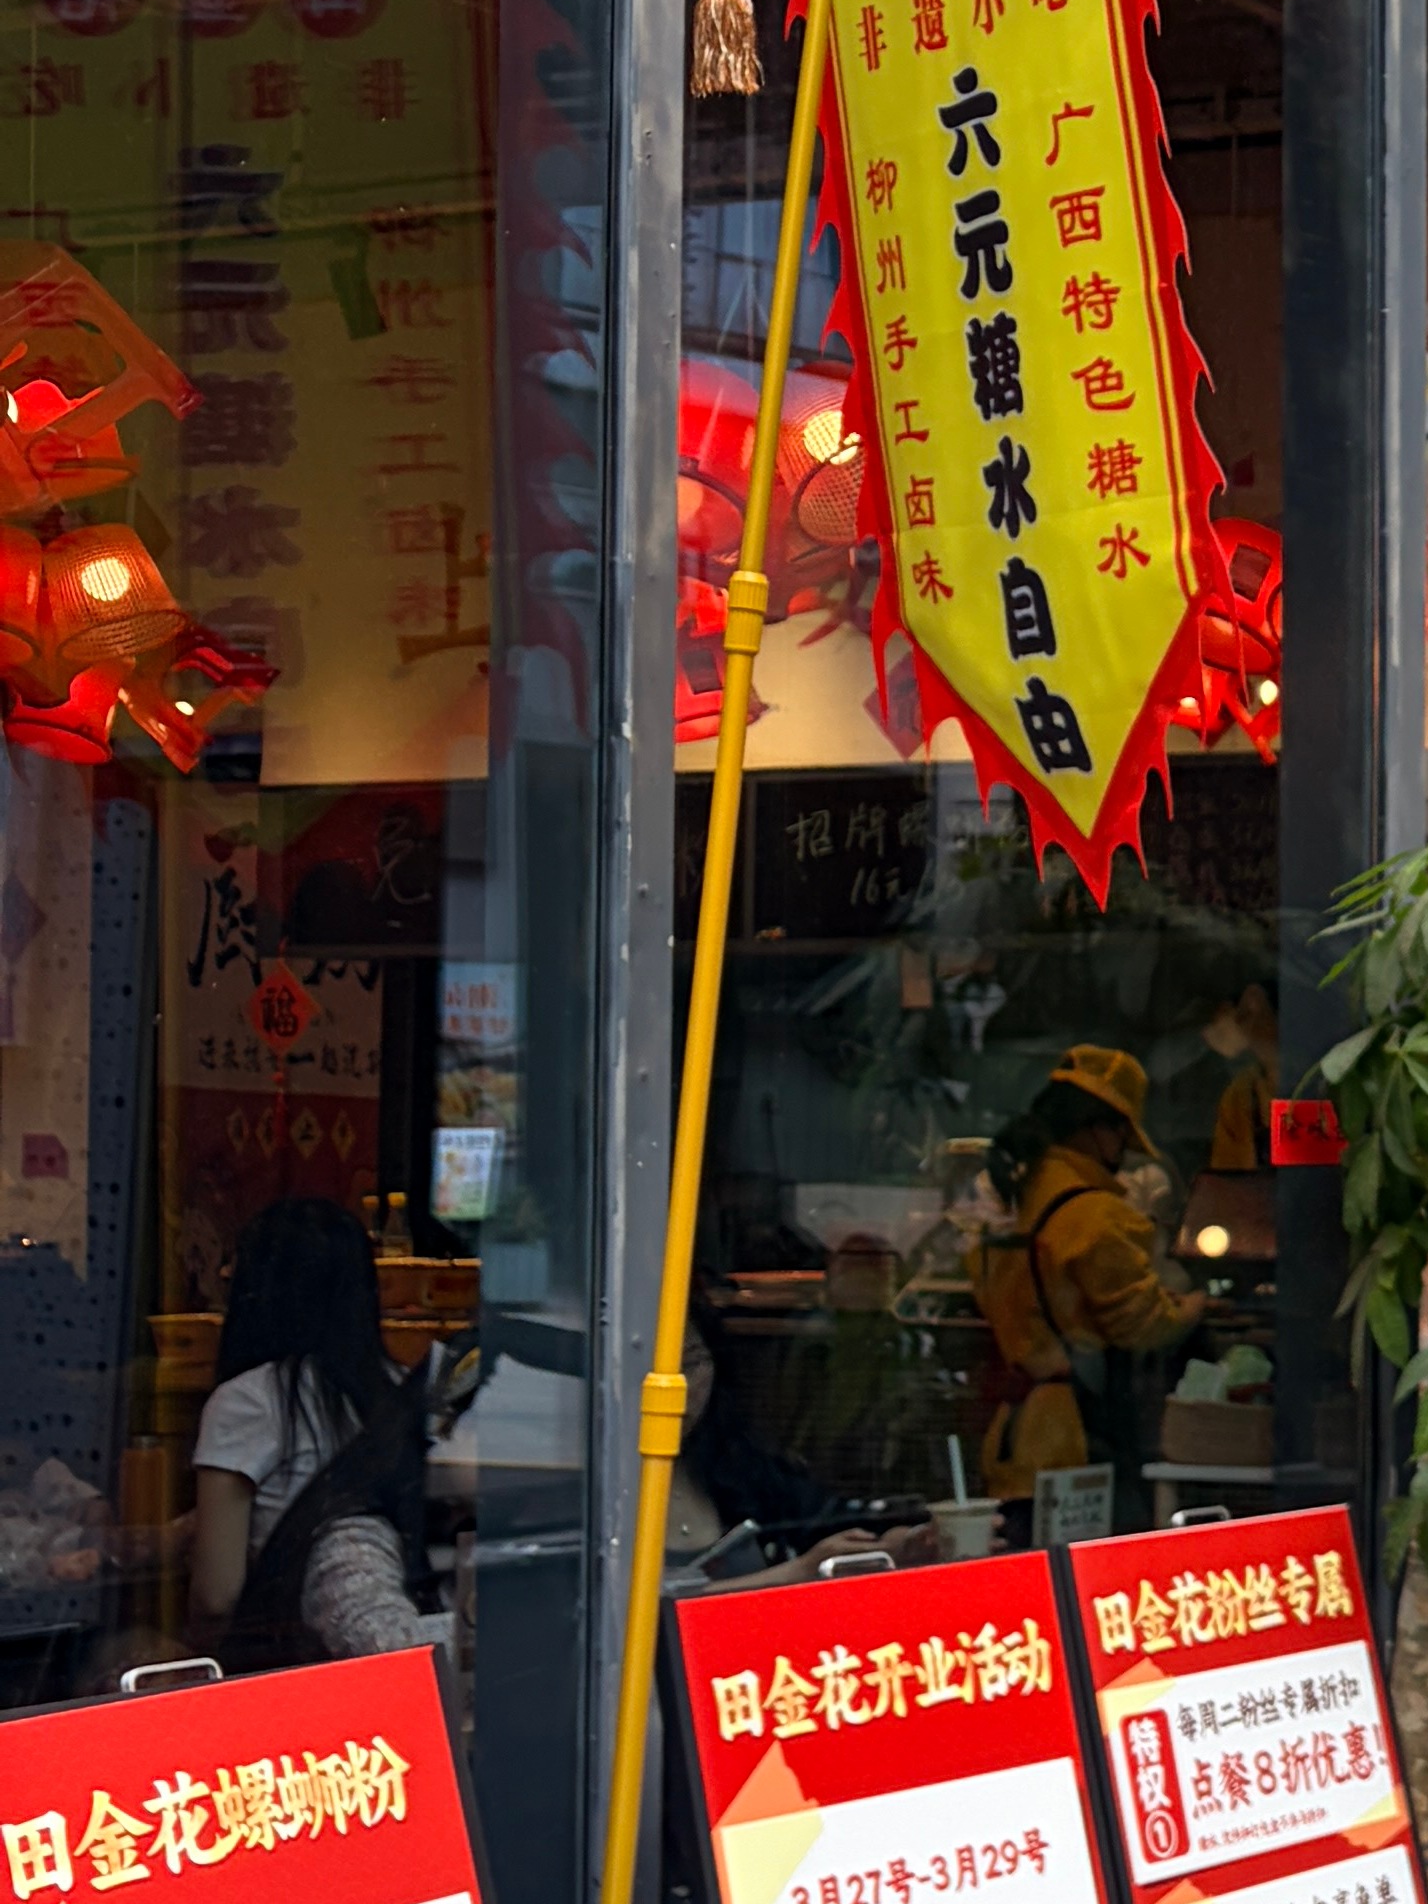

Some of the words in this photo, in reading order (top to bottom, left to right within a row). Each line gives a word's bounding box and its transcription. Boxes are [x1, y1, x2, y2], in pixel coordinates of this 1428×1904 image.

[865, 157, 955, 606] 柳州手工卤味
[936, 65, 1095, 776] 六元糖水自由
[1044, 101, 1152, 581] 广西特色糖水
[711, 1618, 1053, 1743] 田金花开业活动
[1093, 1550, 1354, 1656] 田金花粉丝专属
[1175, 1669, 1360, 1742] 每周二粉丝专属折扣
[1, 1735, 410, 1900] 田金花螺蛳粉
